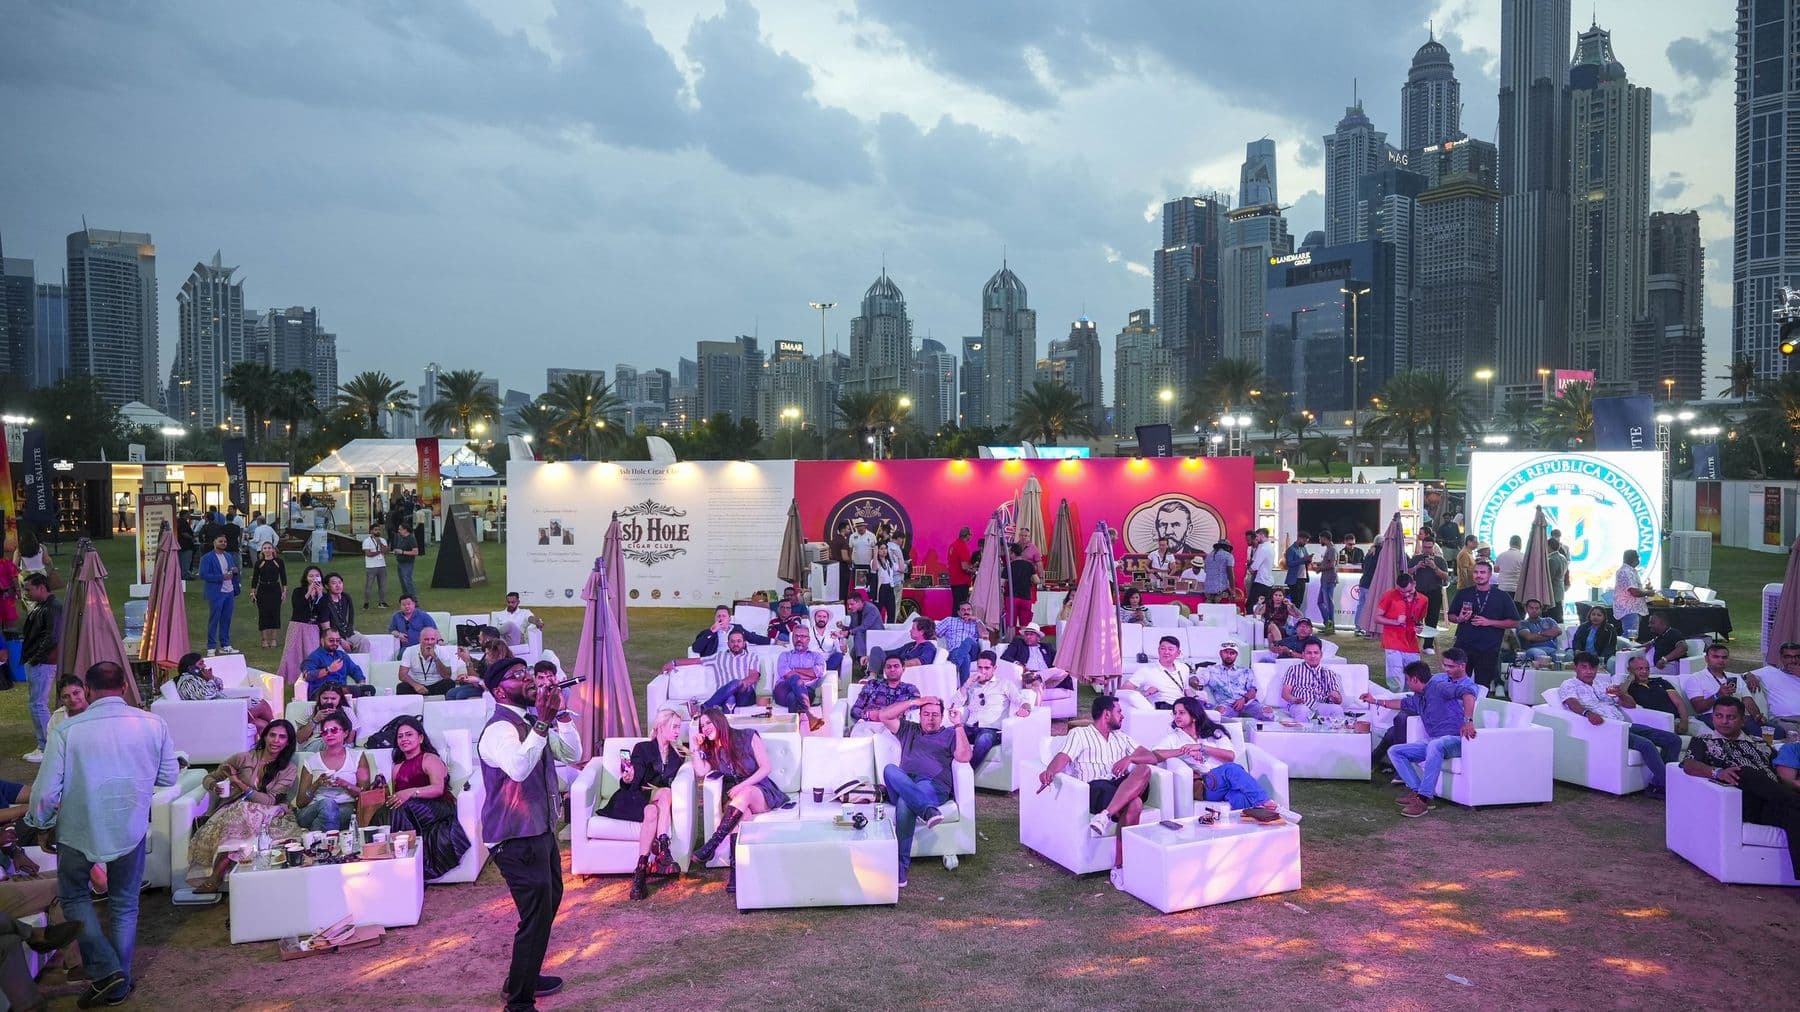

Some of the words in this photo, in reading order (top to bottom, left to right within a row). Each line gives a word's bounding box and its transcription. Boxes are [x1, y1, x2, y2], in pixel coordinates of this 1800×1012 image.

[1388, 151, 1408, 165] MAG
[1276, 252, 1311, 264] LANDMARK
[780, 342, 803, 351] EMAAR
[33, 447, 43, 481] SALUTE
[36, 482, 46, 511] ROYAL
[1506, 473, 1527, 491] DE
[1527, 459, 1601, 480] REPÚBLICA
[1603, 470, 1652, 552] DOMINICANA
